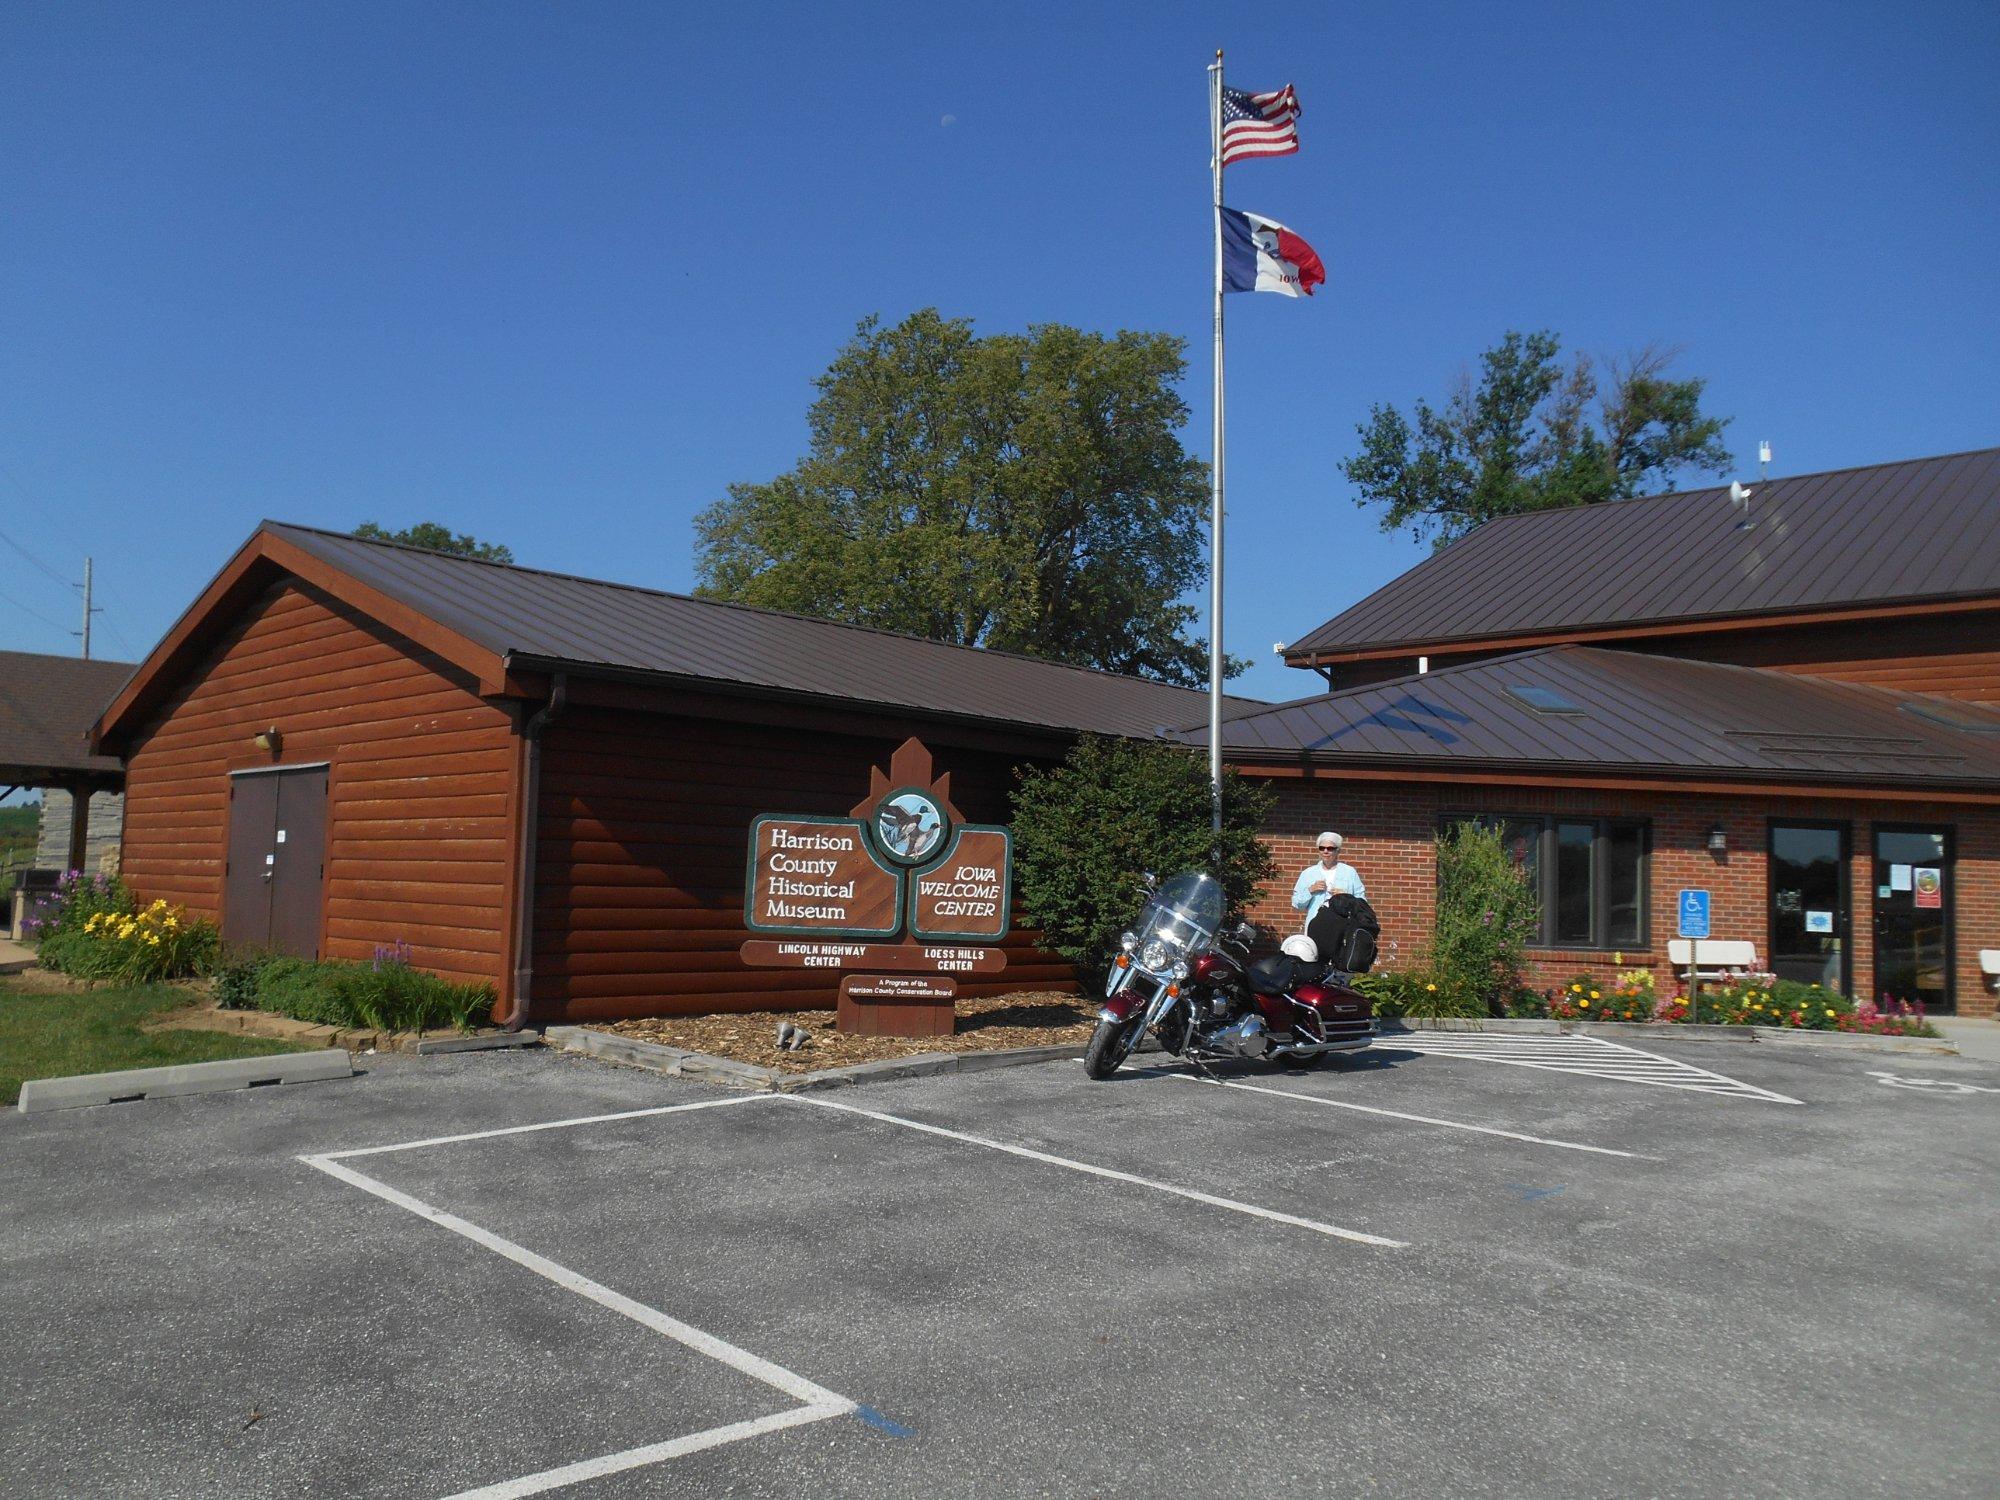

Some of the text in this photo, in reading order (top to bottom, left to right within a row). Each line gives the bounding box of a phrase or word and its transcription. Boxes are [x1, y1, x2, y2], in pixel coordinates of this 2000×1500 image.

[1280, 274, 1300, 283] IOW
[771, 829, 853, 851] Harrison
[769, 853, 838, 877] County
[954, 866, 997, 883] IOWA
[768, 877, 855, 899] Historical
[920, 881, 1000, 900] WELCOME
[766, 900, 846, 920] Museum
[934, 901, 996, 917] CENTER
[778, 944, 866, 956] LINCOLN HIGHWAY
[924, 948, 985, 960] LOESS HILLS
[803, 956, 841, 967] CENTER
[937, 960, 973, 971] CENTER
[885, 979, 909, 987] Program
[874, 987, 895, 995] County
[896, 988, 933, 996] Conservation
